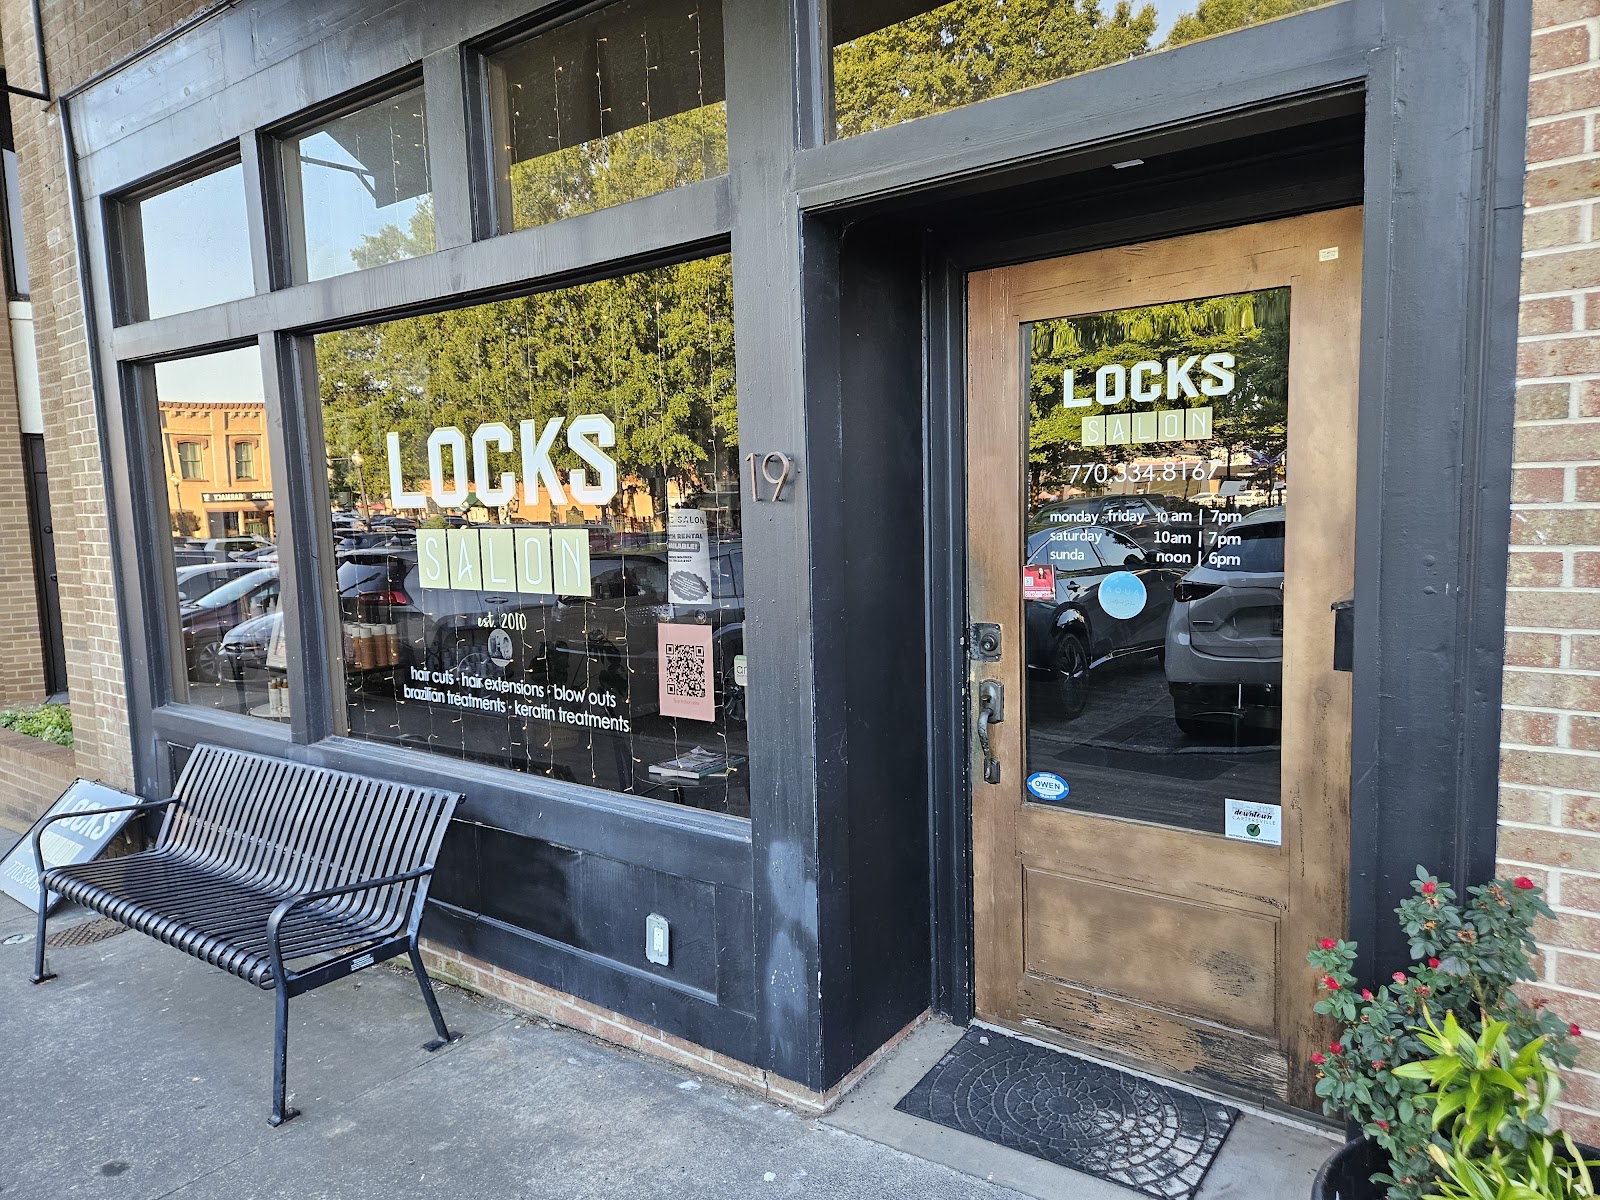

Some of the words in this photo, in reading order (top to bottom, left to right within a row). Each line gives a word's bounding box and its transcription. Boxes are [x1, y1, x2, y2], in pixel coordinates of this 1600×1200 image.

[1063, 352, 1236, 408] LOCKS
[1087, 411, 1206, 443] SALON
[386, 413, 618, 509] LOCKS
[1069, 459, 1222, 484] 770.334.8167
[745, 451, 789, 502] 19
[677, 515, 705, 525] SALON
[1049, 510, 1099, 526] monday
[1107, 510, 1145, 526] friday
[1155, 512, 1169, 524] 10
[1171, 512, 1193, 522] am
[1210, 509, 1242, 526] 7pm
[677, 532, 704, 540] RENTAL
[1049, 529, 1103, 545] saturday
[1153, 530, 1192, 545] 10am
[1208, 531, 1242, 549] 7pm
[425, 536, 582, 589] SALON
[1049, 547, 1085, 560] sunda
[1156, 552, 1192, 564] noon
[1208, 551, 1241, 569] 6pm
[1105, 586, 1140, 597] AQUA
[477, 611, 497, 629] est.
[500, 612, 528, 631] 2010
[410, 665, 431, 682] hair
[431, 670, 455, 686] cuts
[461, 672, 484, 689] hair
[484, 676, 545, 698] extensions
[553, 683, 586, 703] blow
[588, 690, 617, 708] outs
[403, 683, 446, 704] brazilian
[446, 689, 507, 714] treatments
[514, 699, 556, 721] keratin
[558, 706, 630, 733] treatments
[1035, 780, 1061, 790] OWEN
[1231, 815, 1276, 826] CARTERSVILLE
[1234, 809, 1273, 820] downtown
